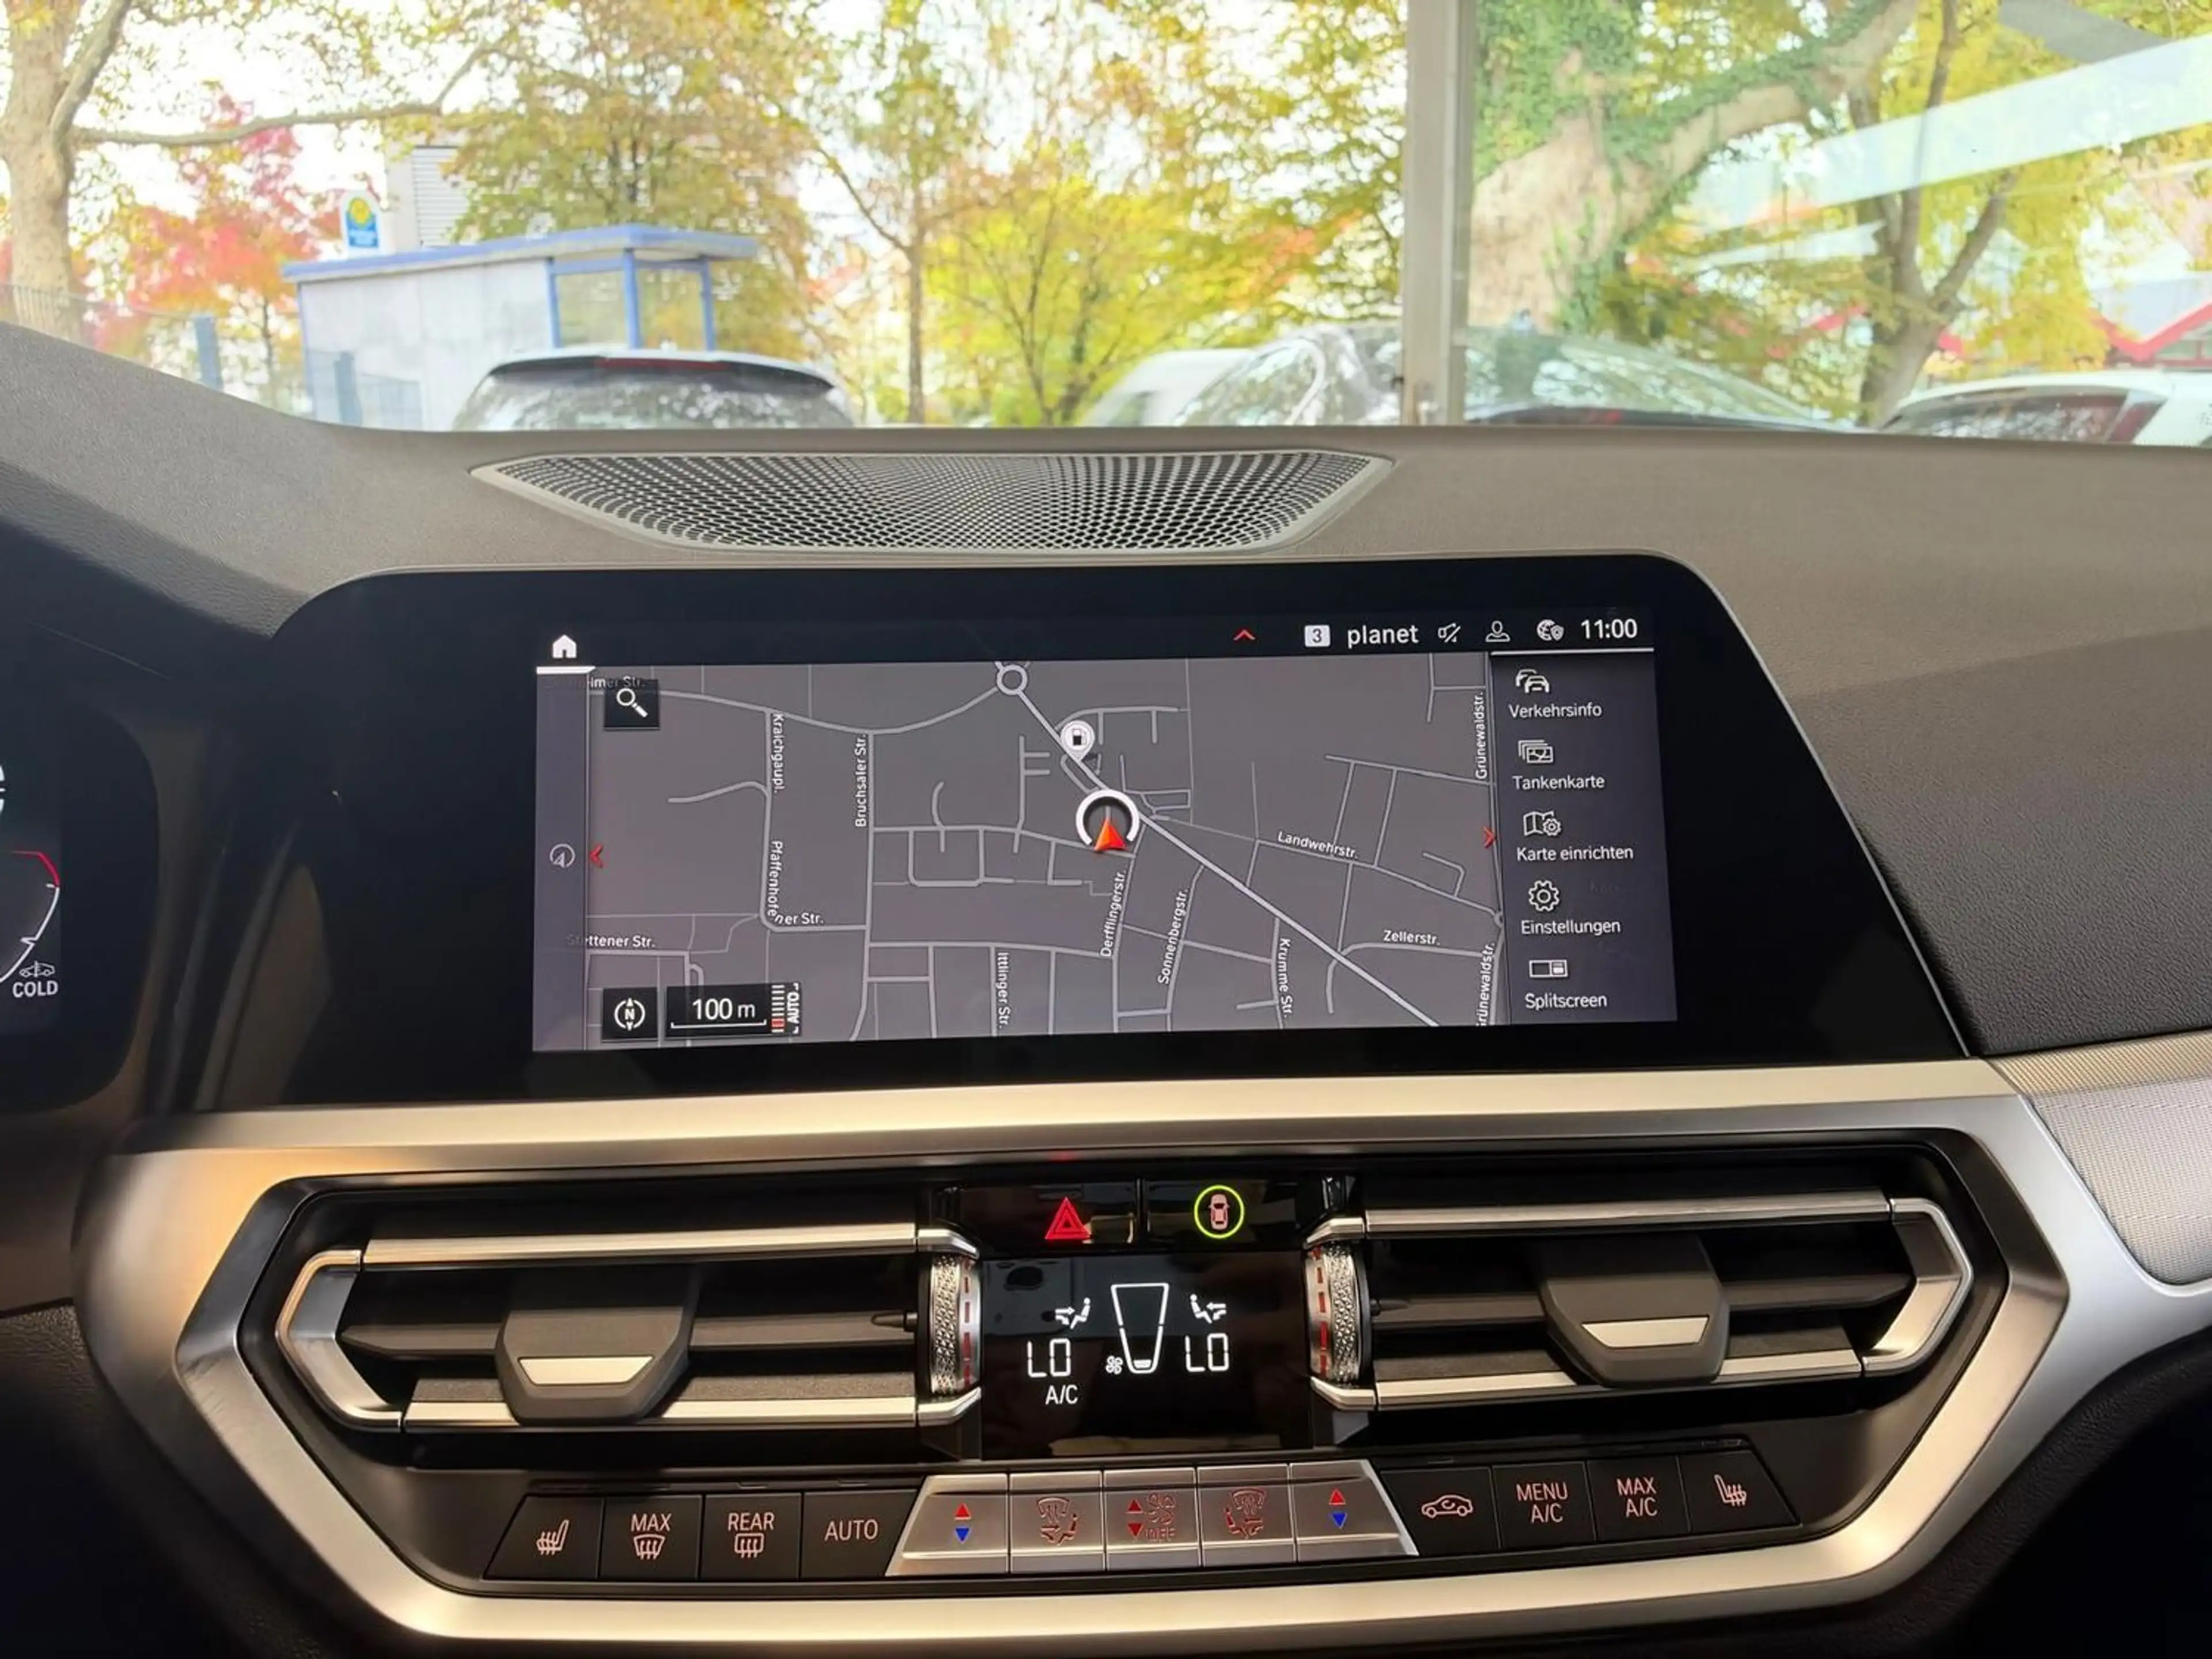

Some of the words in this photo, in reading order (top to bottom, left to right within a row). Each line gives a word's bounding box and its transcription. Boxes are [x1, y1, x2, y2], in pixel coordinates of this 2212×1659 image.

[1312, 628, 1323, 643] 3
[1347, 624, 1419, 649] planet
[1581, 619, 1638, 639] 11:00
[1508, 702, 1603, 718] Verkehrsinfo
[854, 733, 867, 756] Str.
[1474, 692, 1488, 779] Grünewaldstr.
[771, 714, 785, 794] Kraichgaupl.
[855, 758, 867, 827] Bruchsaler
[1512, 774, 1605, 790] Tankenkarte
[1278, 831, 1358, 859] Landwehrstr.
[1517, 847, 1556, 862] Karte
[1560, 845, 1634, 860] einrichten
[767, 840, 799, 925] Pfaffenhofener
[801, 912, 825, 925] Str.
[1100, 869, 1127, 957] Derfflingerstr.
[1157, 888, 1189, 985] Sonnenbergstr.
[1384, 929, 1441, 945] Zellerstr.
[1521, 920, 1622, 935] Einstellungen
[632, 934, 656, 948] Str.
[1277, 938, 1291, 993] Krumme
[13, 980, 58, 998] COLD
[692, 998, 733, 1020] 100
[737, 1003, 756, 1018] m
[787, 991, 800, 1024] AUTO
[1280, 995, 1293, 1018] Str.
[1524, 993, 1608, 1010] Splitscreen
[998, 1006, 1012, 1029] Str.
[1044, 1384, 1078, 1406] A/C
[1516, 1482, 1568, 1501] MENU
[1616, 1476, 1657, 1496] MAX
[1531, 1503, 1563, 1524] A/C
[1625, 1497, 1658, 1517] A/C
[630, 1513, 672, 1532] MAX
[727, 1512, 775, 1531] REAR
[824, 1519, 880, 1541] AUTO
